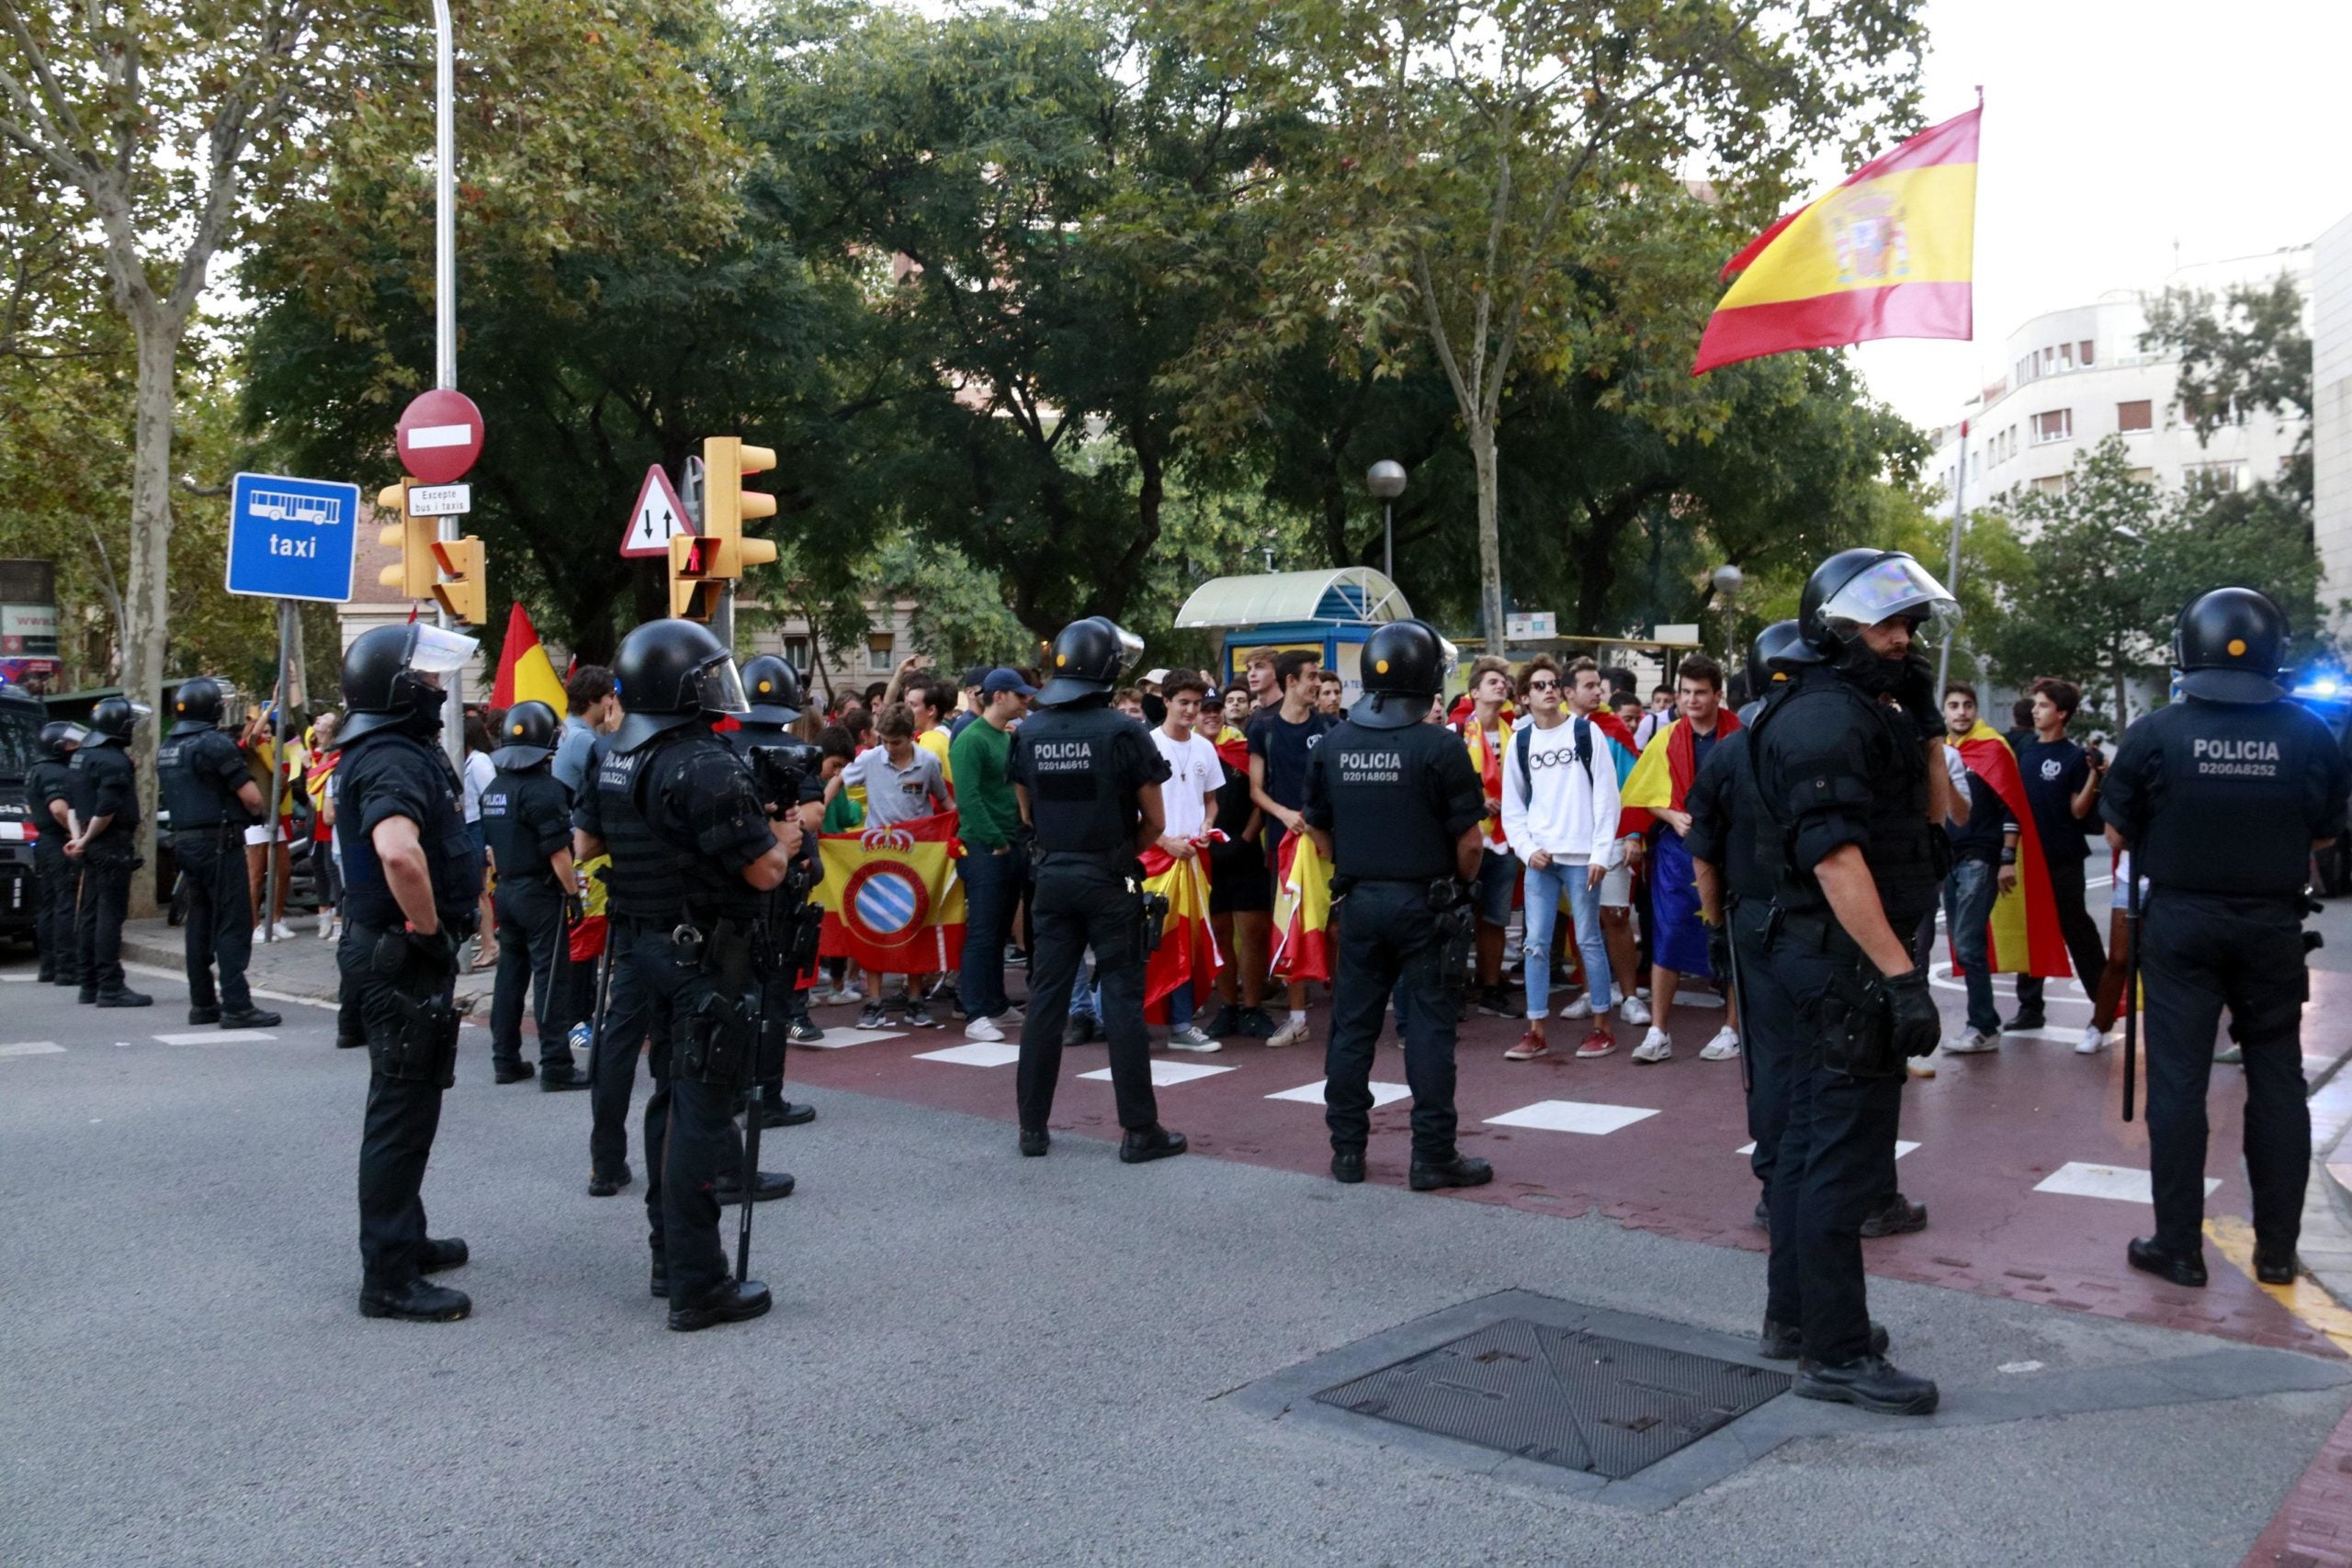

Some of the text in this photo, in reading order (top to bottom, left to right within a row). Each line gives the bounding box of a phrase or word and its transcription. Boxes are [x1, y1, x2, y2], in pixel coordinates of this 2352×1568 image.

[423, 491, 457, 500] Excepte
[415, 503, 431, 513] bus
[442, 502, 464, 511] taxis
[270, 534, 316, 558] taxi
[1035, 742, 1091, 760] POLICIA
[2193, 739, 2280, 761] POLICIA
[1340, 752, 1402, 769] POLICIA
